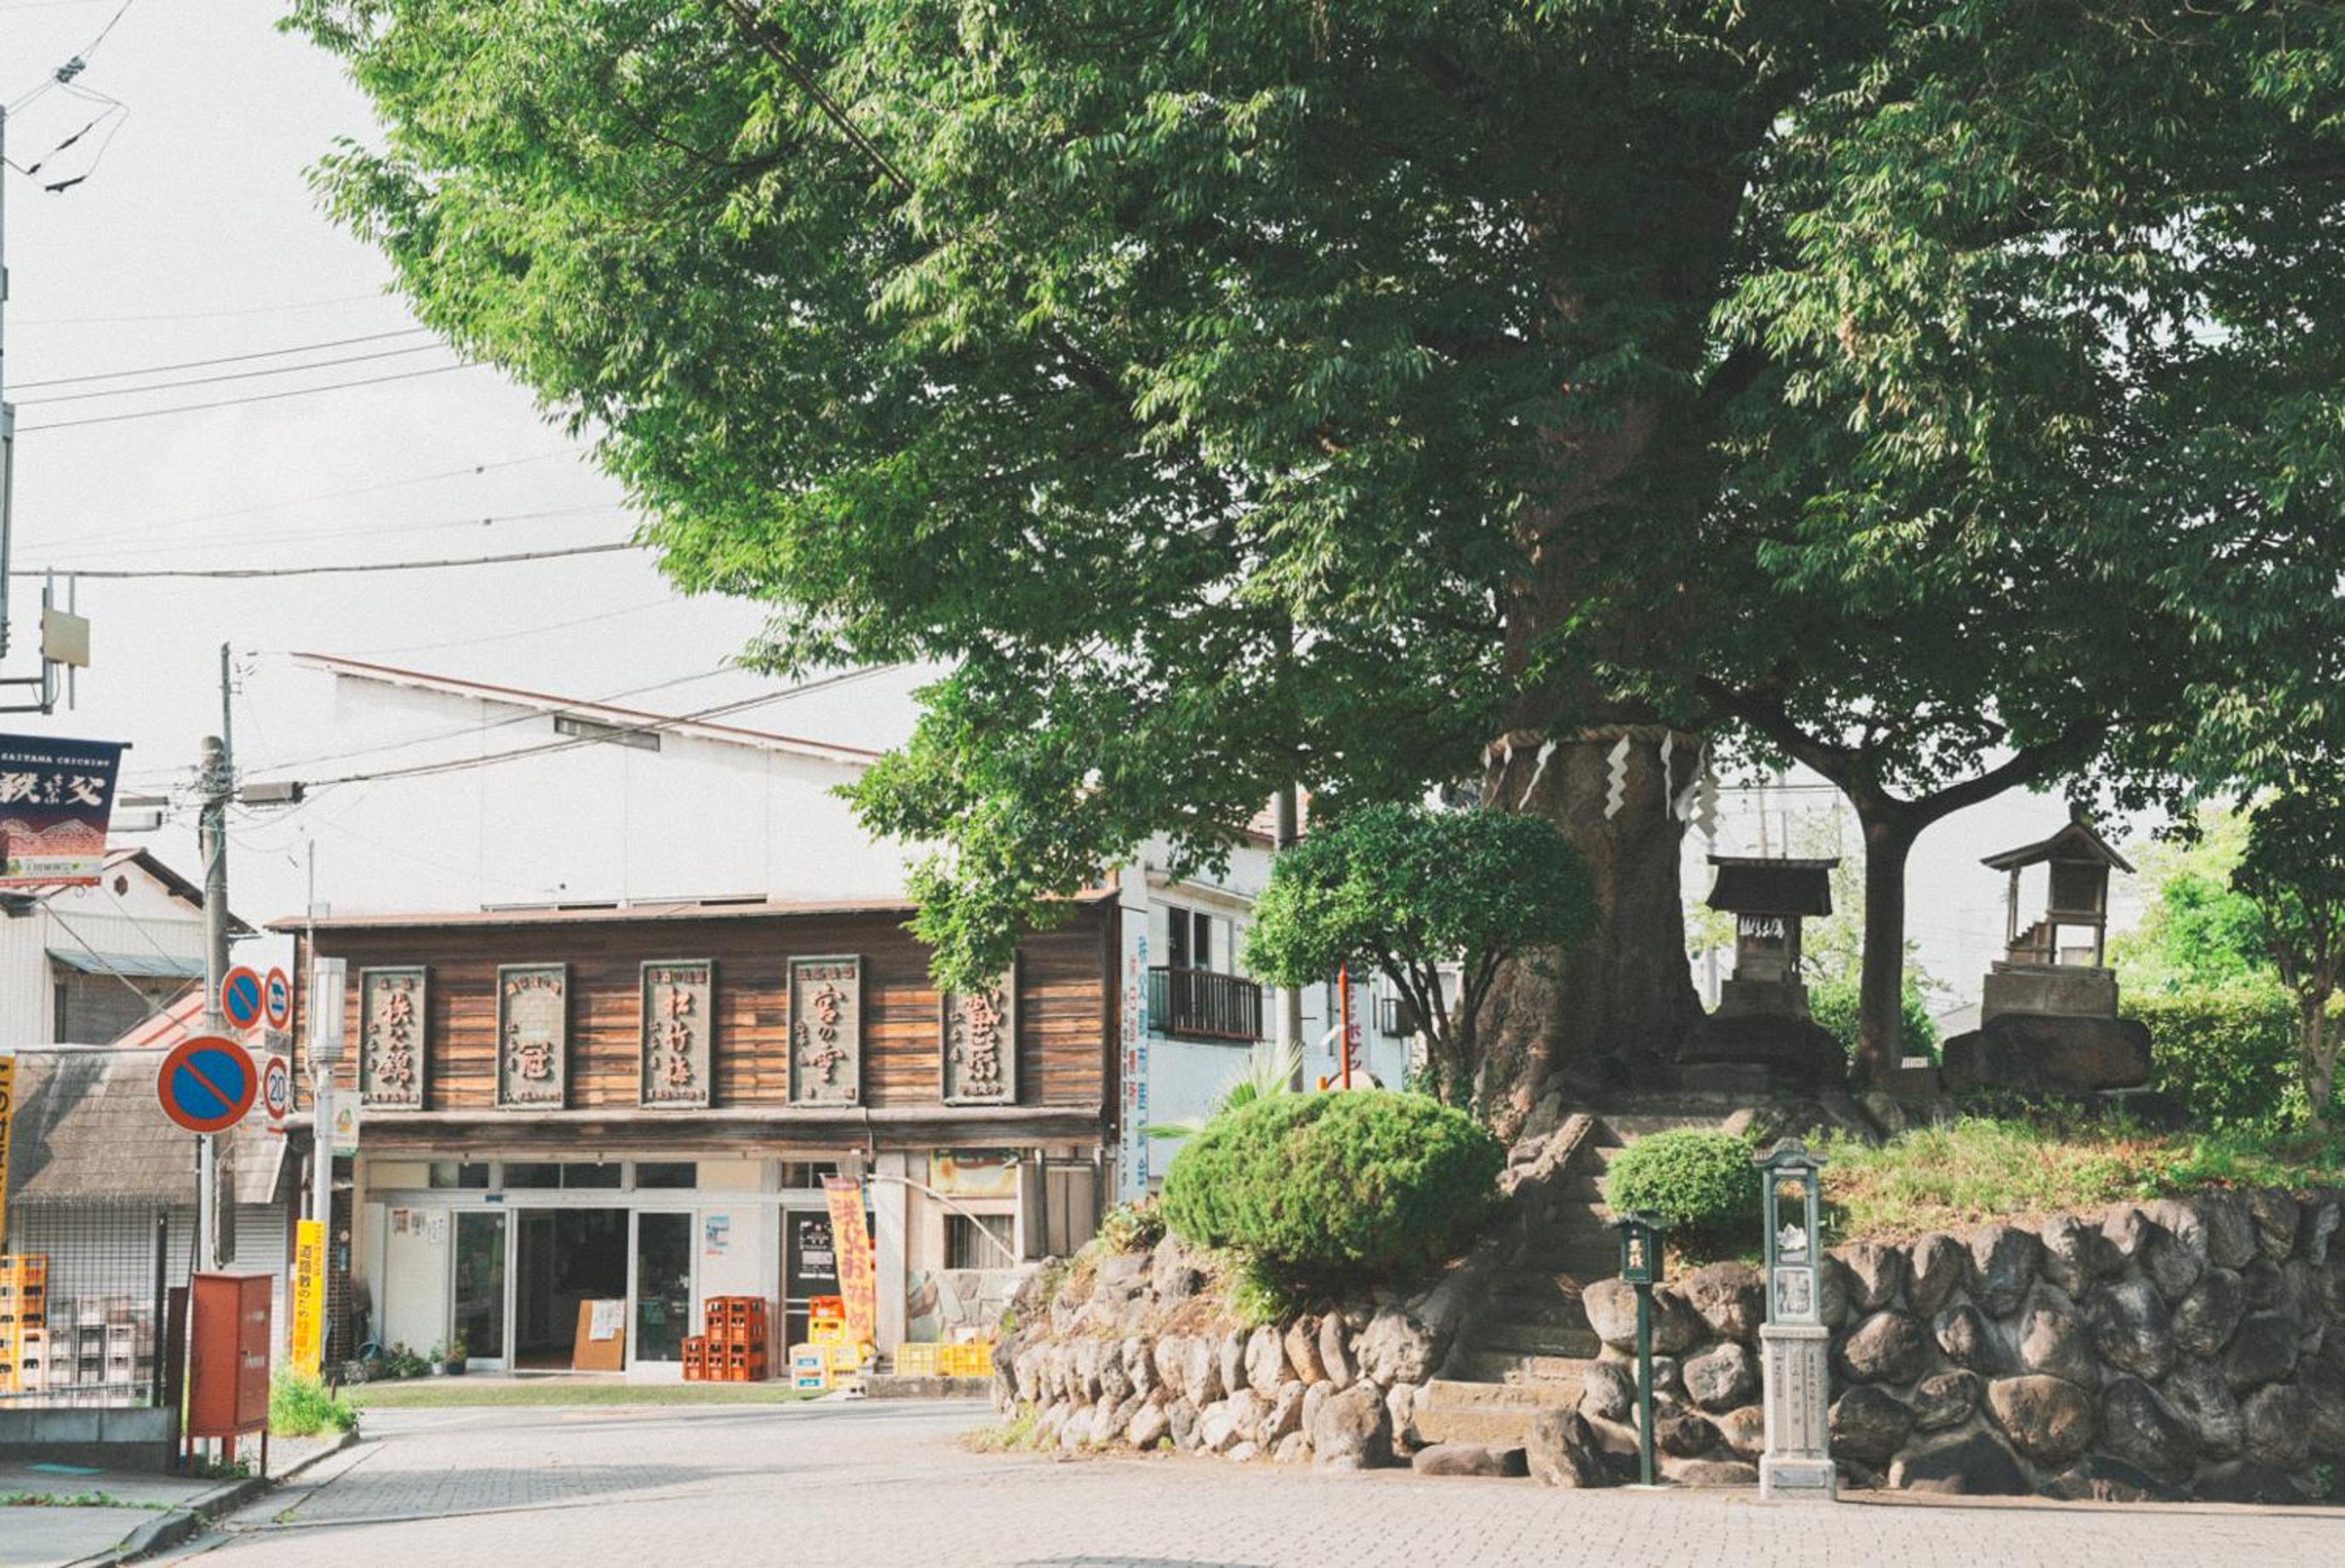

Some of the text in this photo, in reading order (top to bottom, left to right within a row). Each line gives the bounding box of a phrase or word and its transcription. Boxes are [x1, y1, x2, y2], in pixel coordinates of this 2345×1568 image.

[1, 753, 110, 767] SAITAMA CHICHIBU
[663, 987, 691, 1084] 松竹梅
[811, 983, 846, 1083] 宮の雪
[270, 1075, 285, 1102] 20
